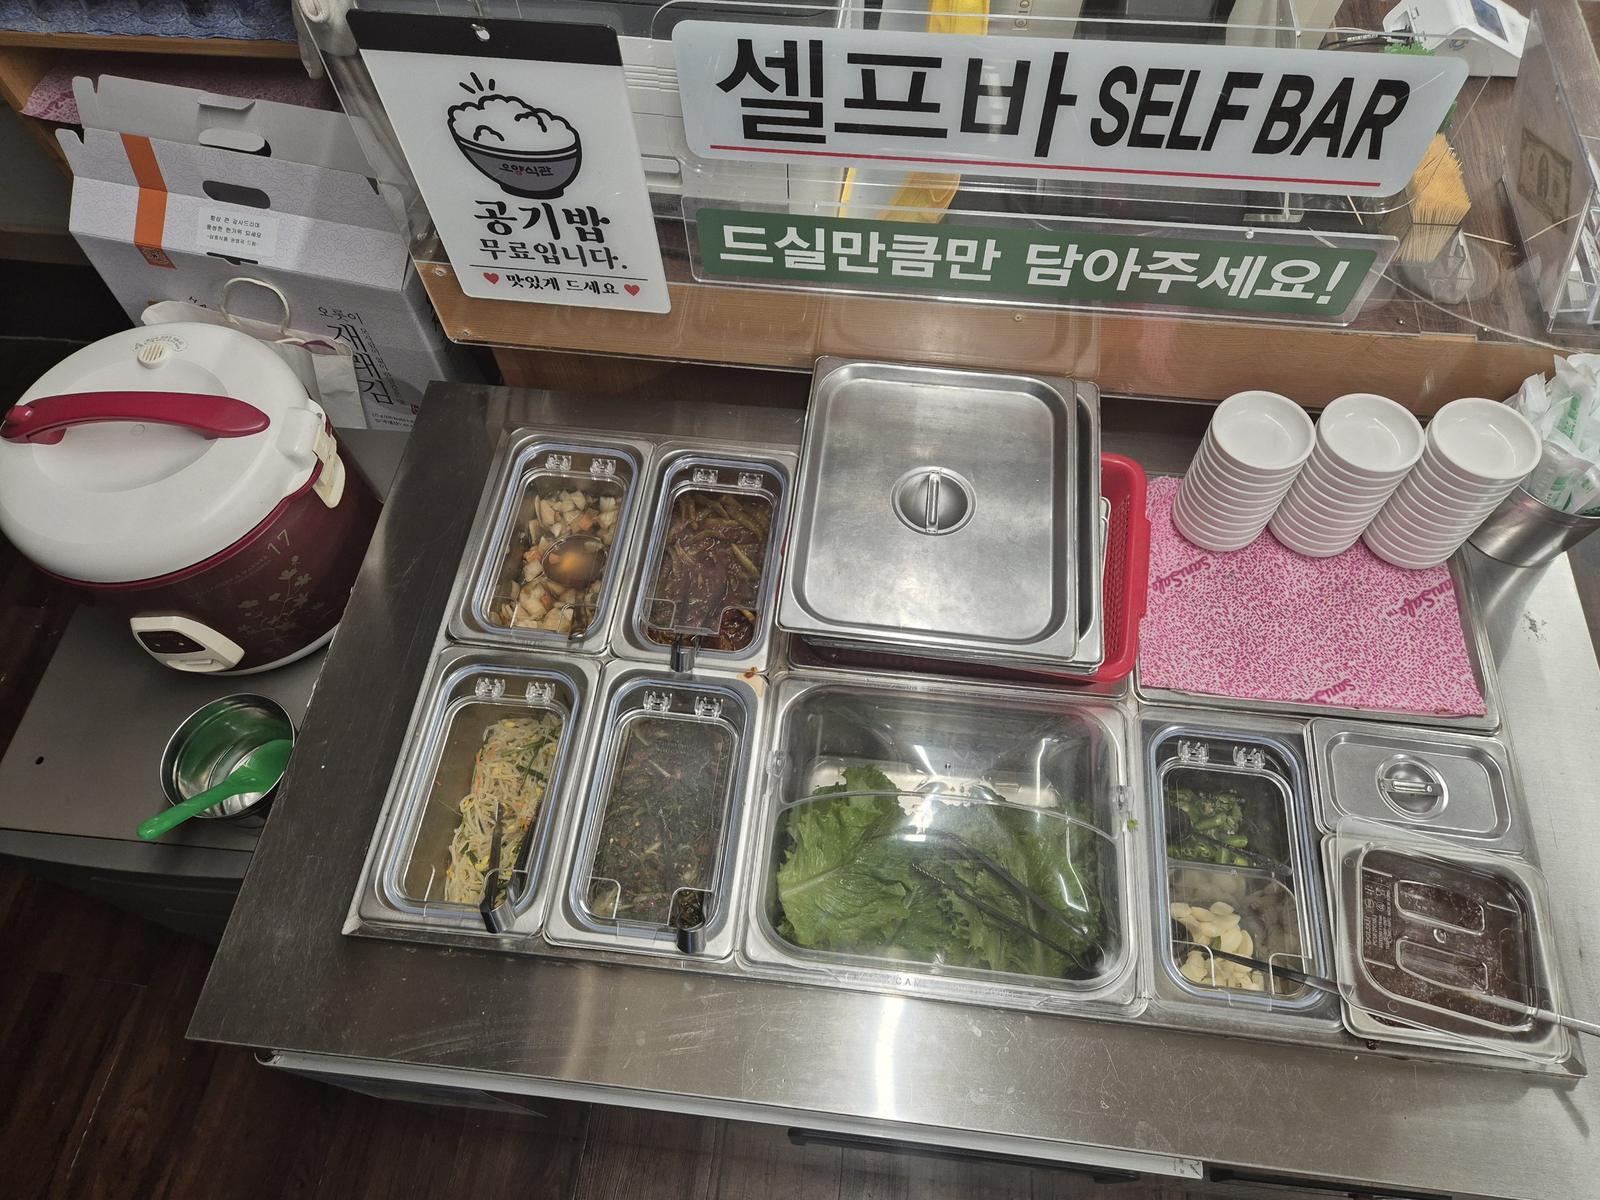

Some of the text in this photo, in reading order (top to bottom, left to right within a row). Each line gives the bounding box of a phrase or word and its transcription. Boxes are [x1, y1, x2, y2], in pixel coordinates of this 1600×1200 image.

[715, 38, 1411, 161] 셀프바 SELF BAR
[474, 201, 611, 243] 공기밥
[479, 238, 628, 270] 무료입니다.
[720, 225, 1350, 305] 드실만큼만 담아주세요!
[505, 273, 619, 295] 맛있게 드세요
[1398, 580, 1452, 618] aniSafe
